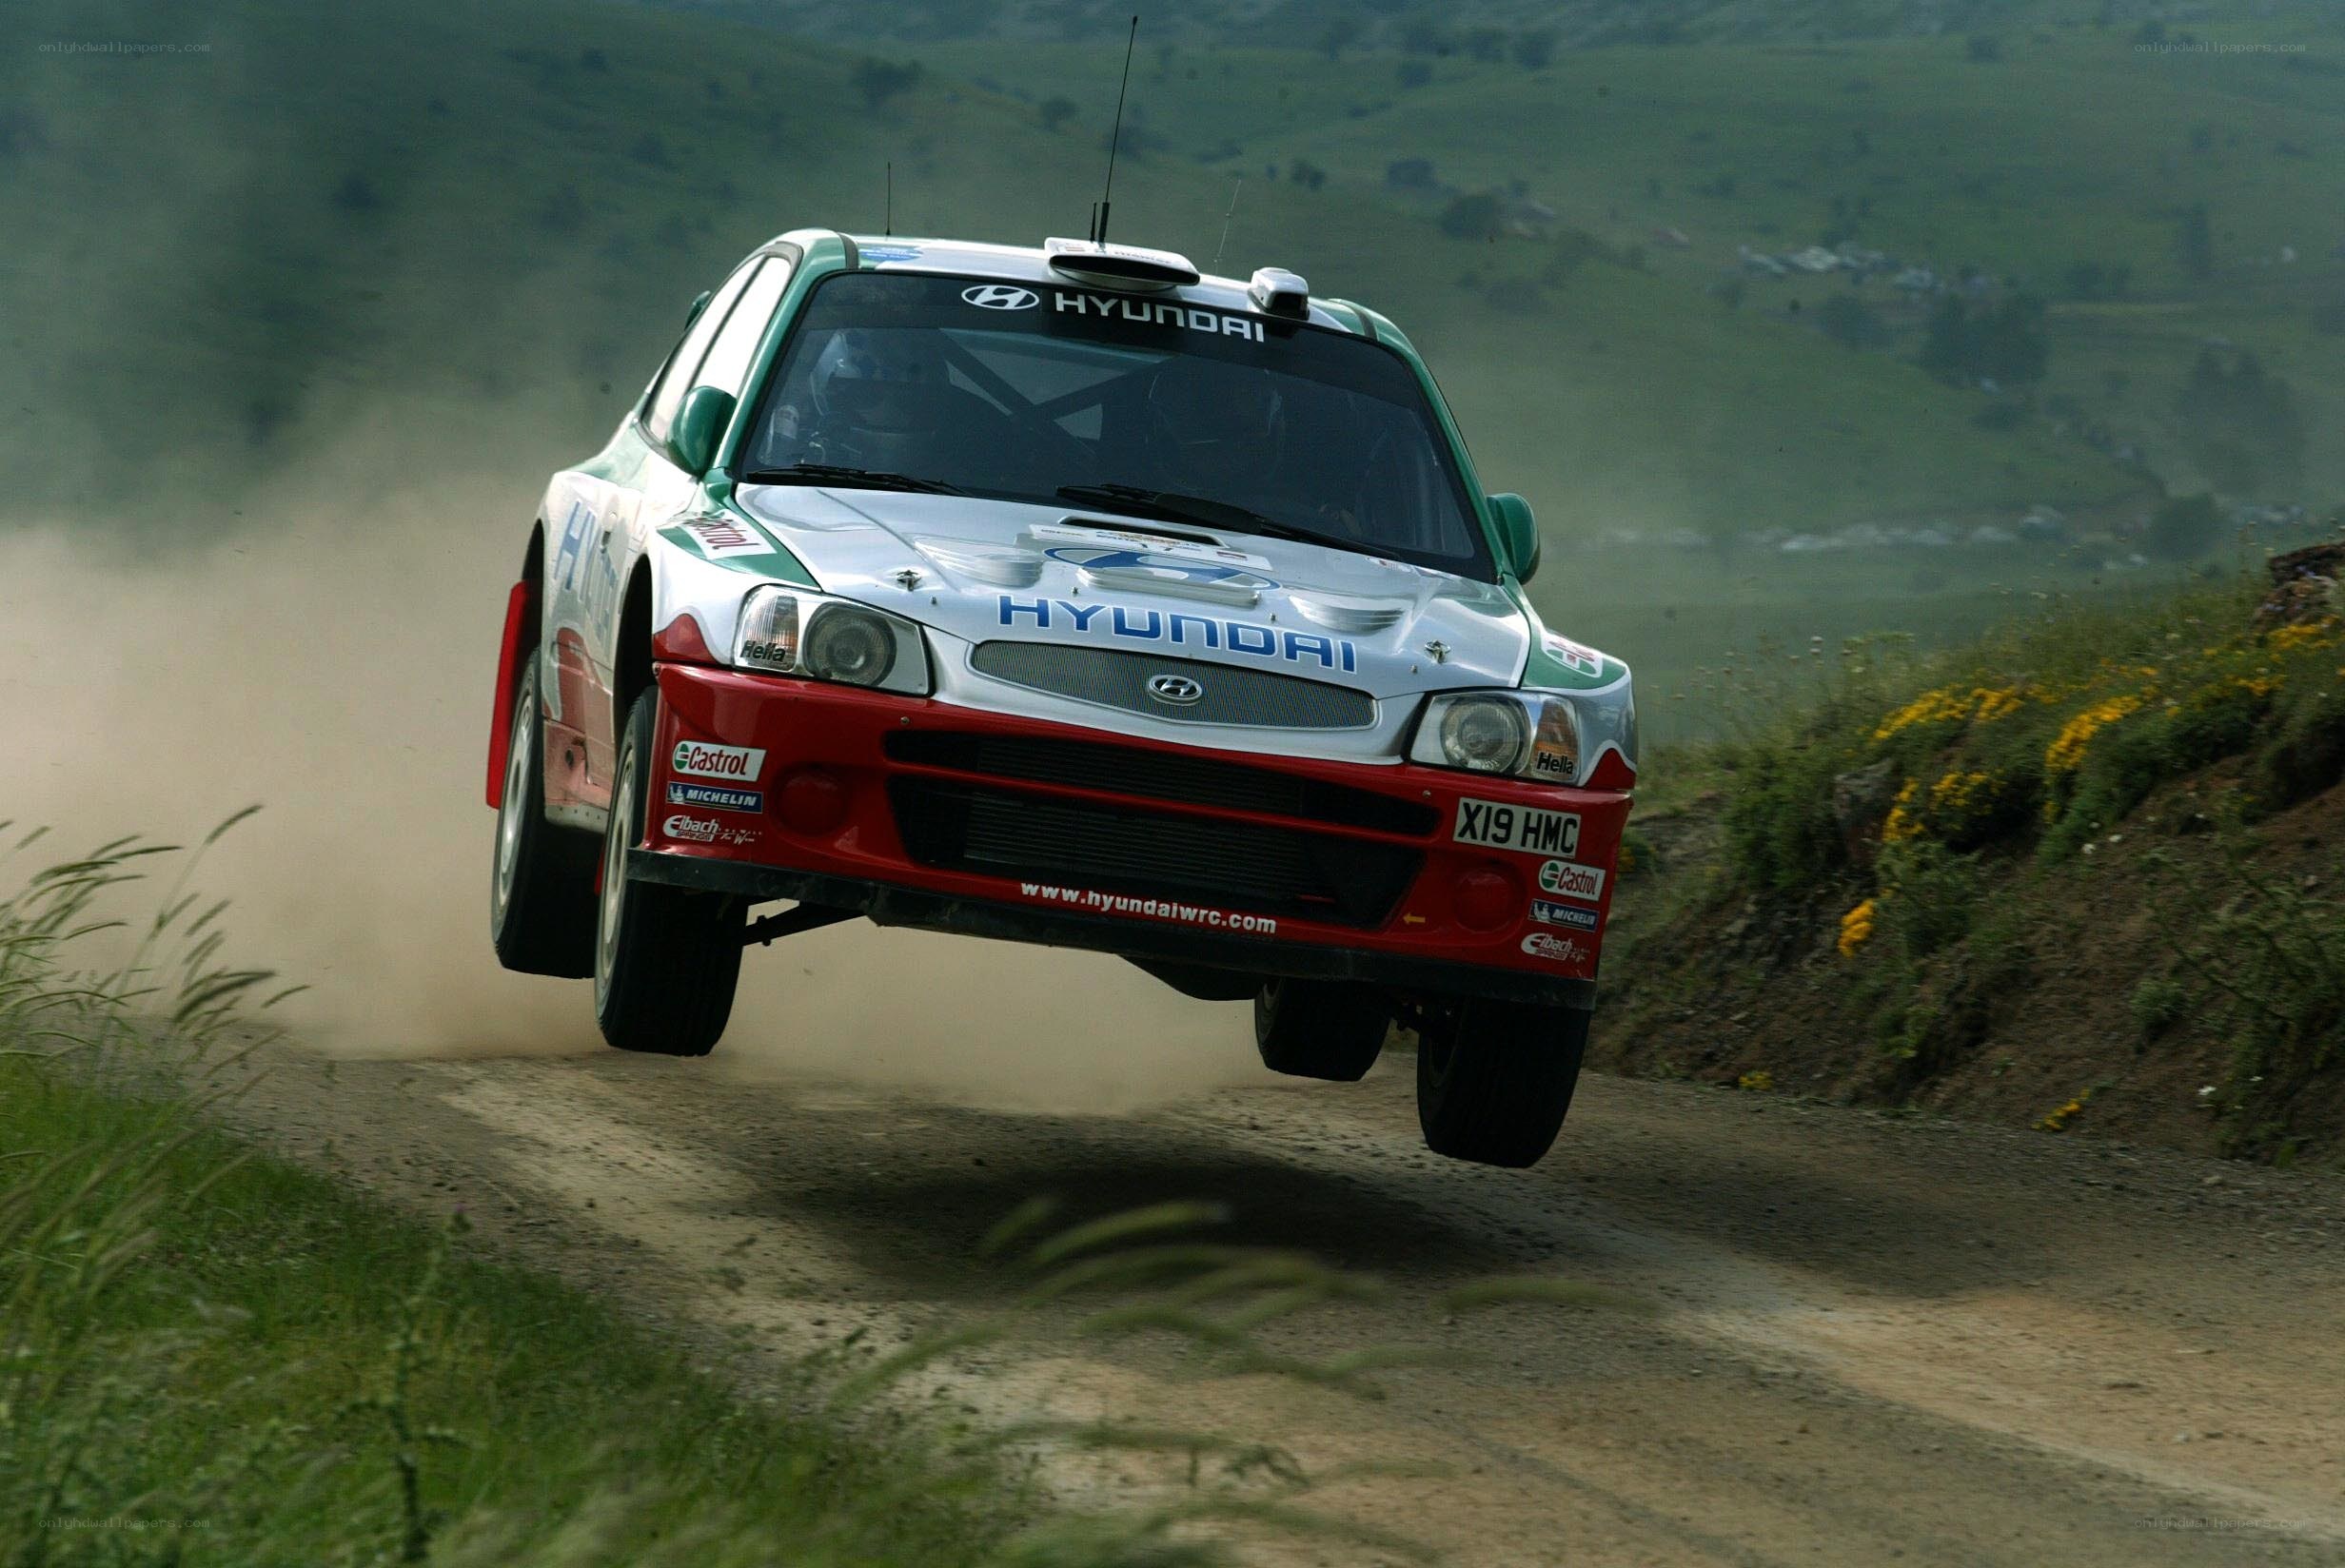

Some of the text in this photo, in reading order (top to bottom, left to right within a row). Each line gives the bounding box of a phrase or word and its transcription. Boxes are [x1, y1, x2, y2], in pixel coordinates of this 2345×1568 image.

[1054, 291, 1265, 343] HYUNDAI
[998, 594, 1358, 676] HYUNDAI
[739, 638, 787, 663] Hella
[688, 746, 750, 776] Castrol
[1536, 752, 1574, 775] Hella
[685, 788, 759, 807] MICHELIN
[1457, 801, 1578, 854] X19 HMC
[1557, 866, 1600, 896] Castrol
[1020, 881, 1277, 934] www.hyundaiwrc.com
[1551, 907, 1597, 926] MICHELIN
